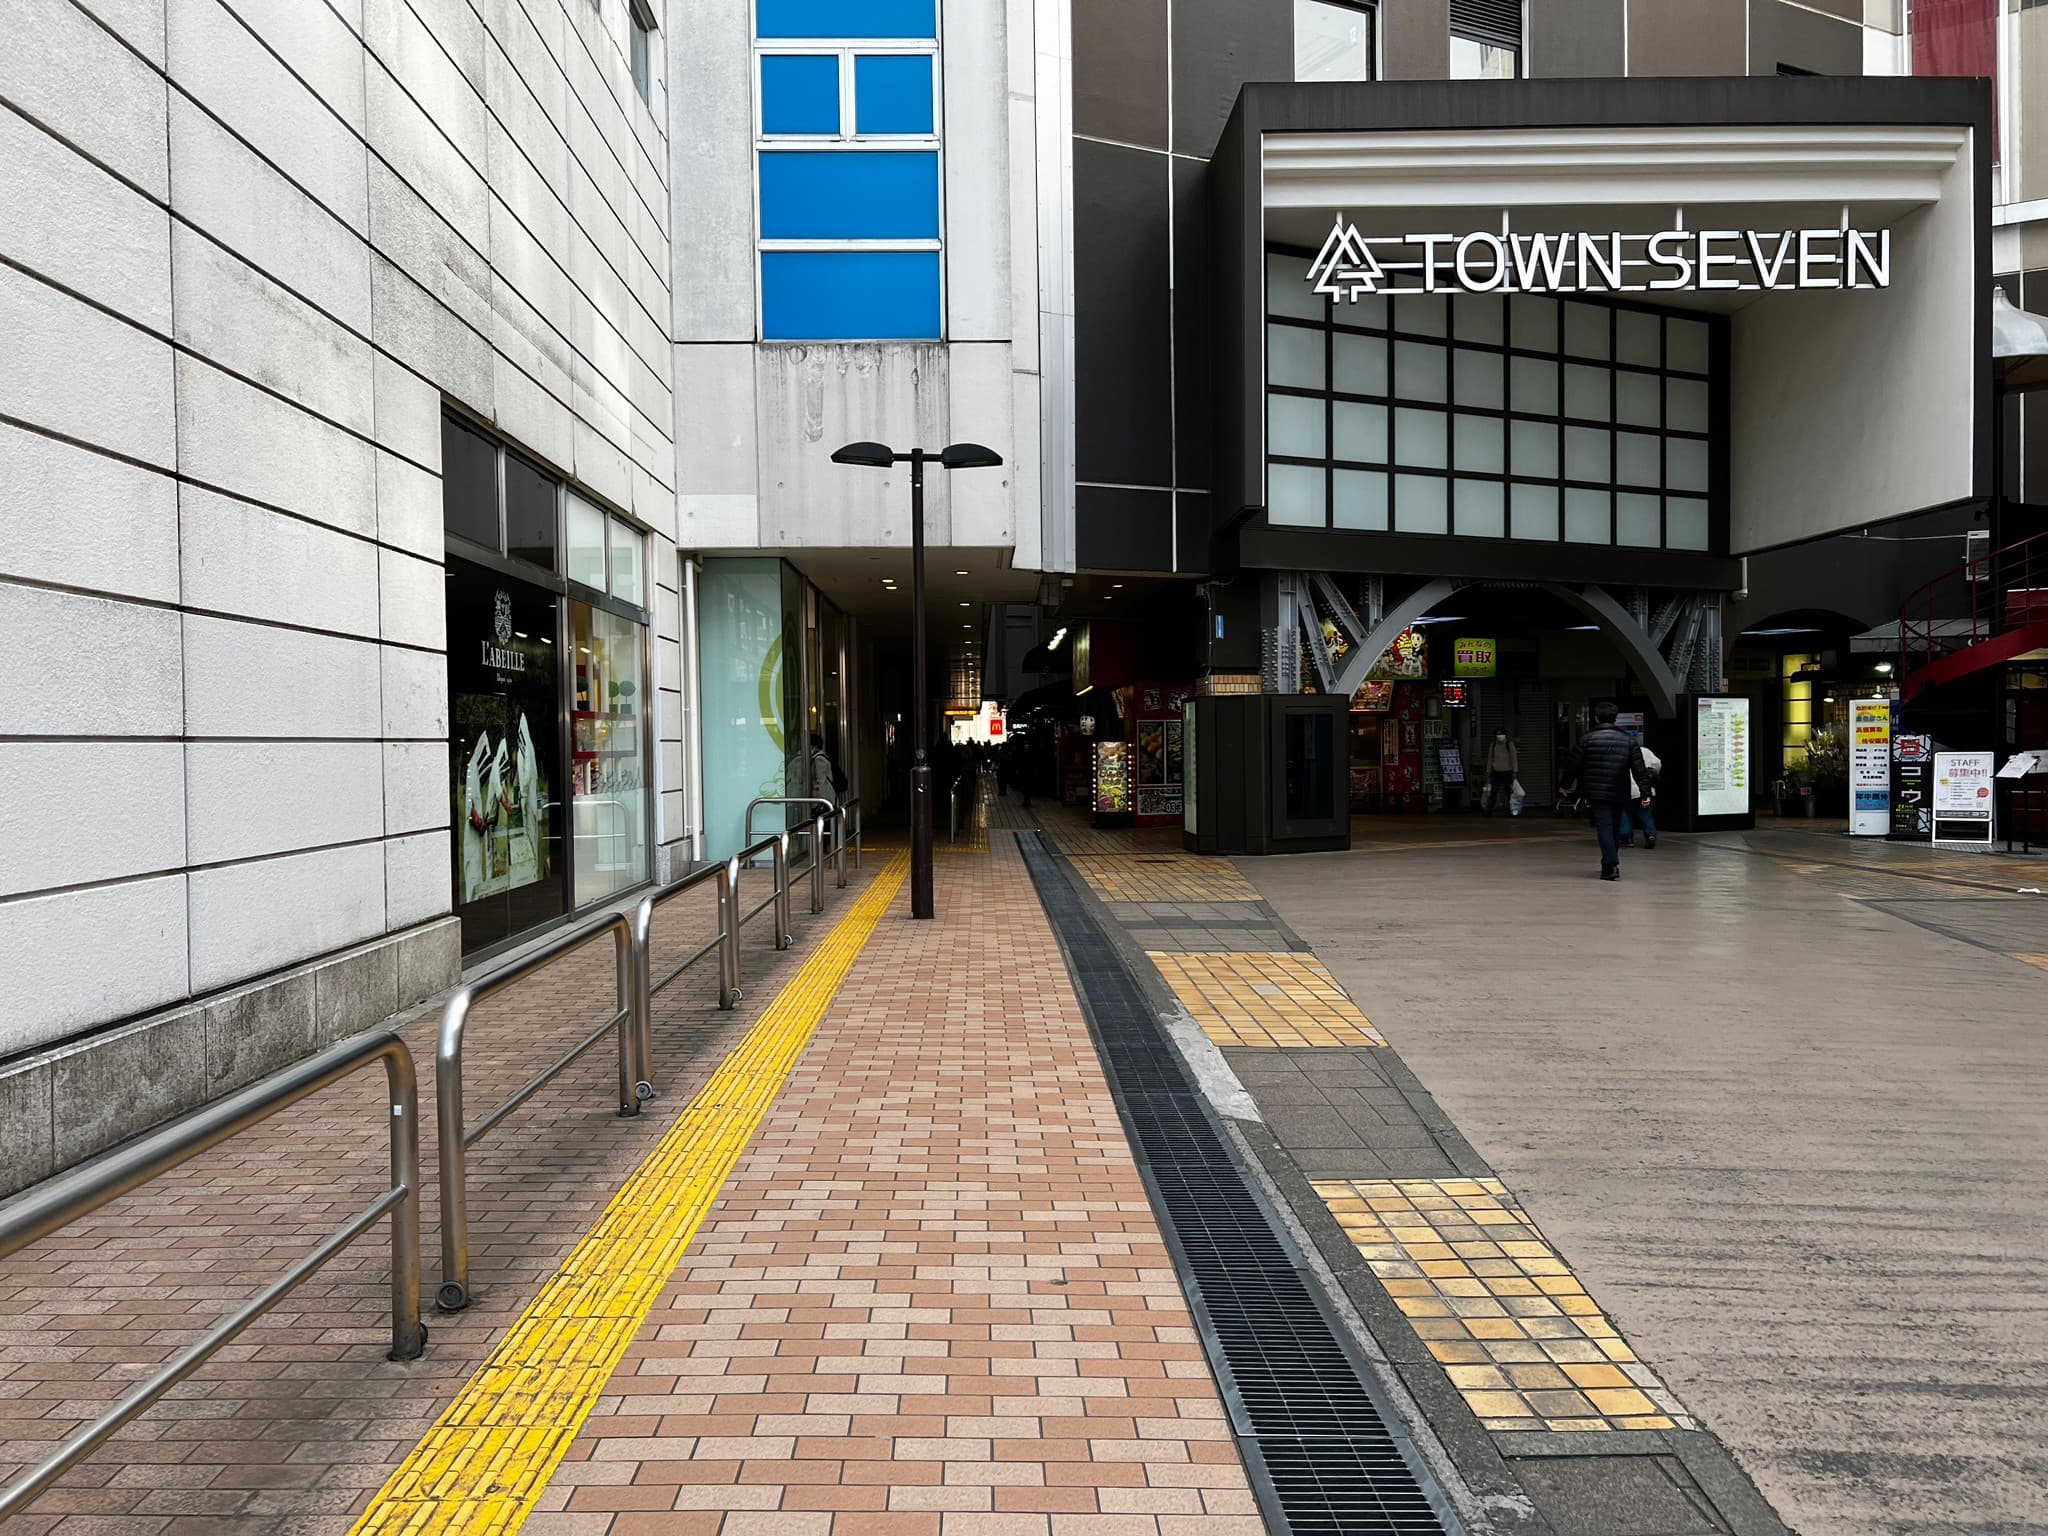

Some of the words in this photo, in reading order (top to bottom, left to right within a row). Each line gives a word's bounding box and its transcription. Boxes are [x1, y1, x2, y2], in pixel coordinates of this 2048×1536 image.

[1404, 231, 1622, 293] TOWN
[1647, 228, 1891, 290] SEVEN
[481, 640, 525, 671] L'ABEILLE
[1458, 650, 1491, 663] 買取
